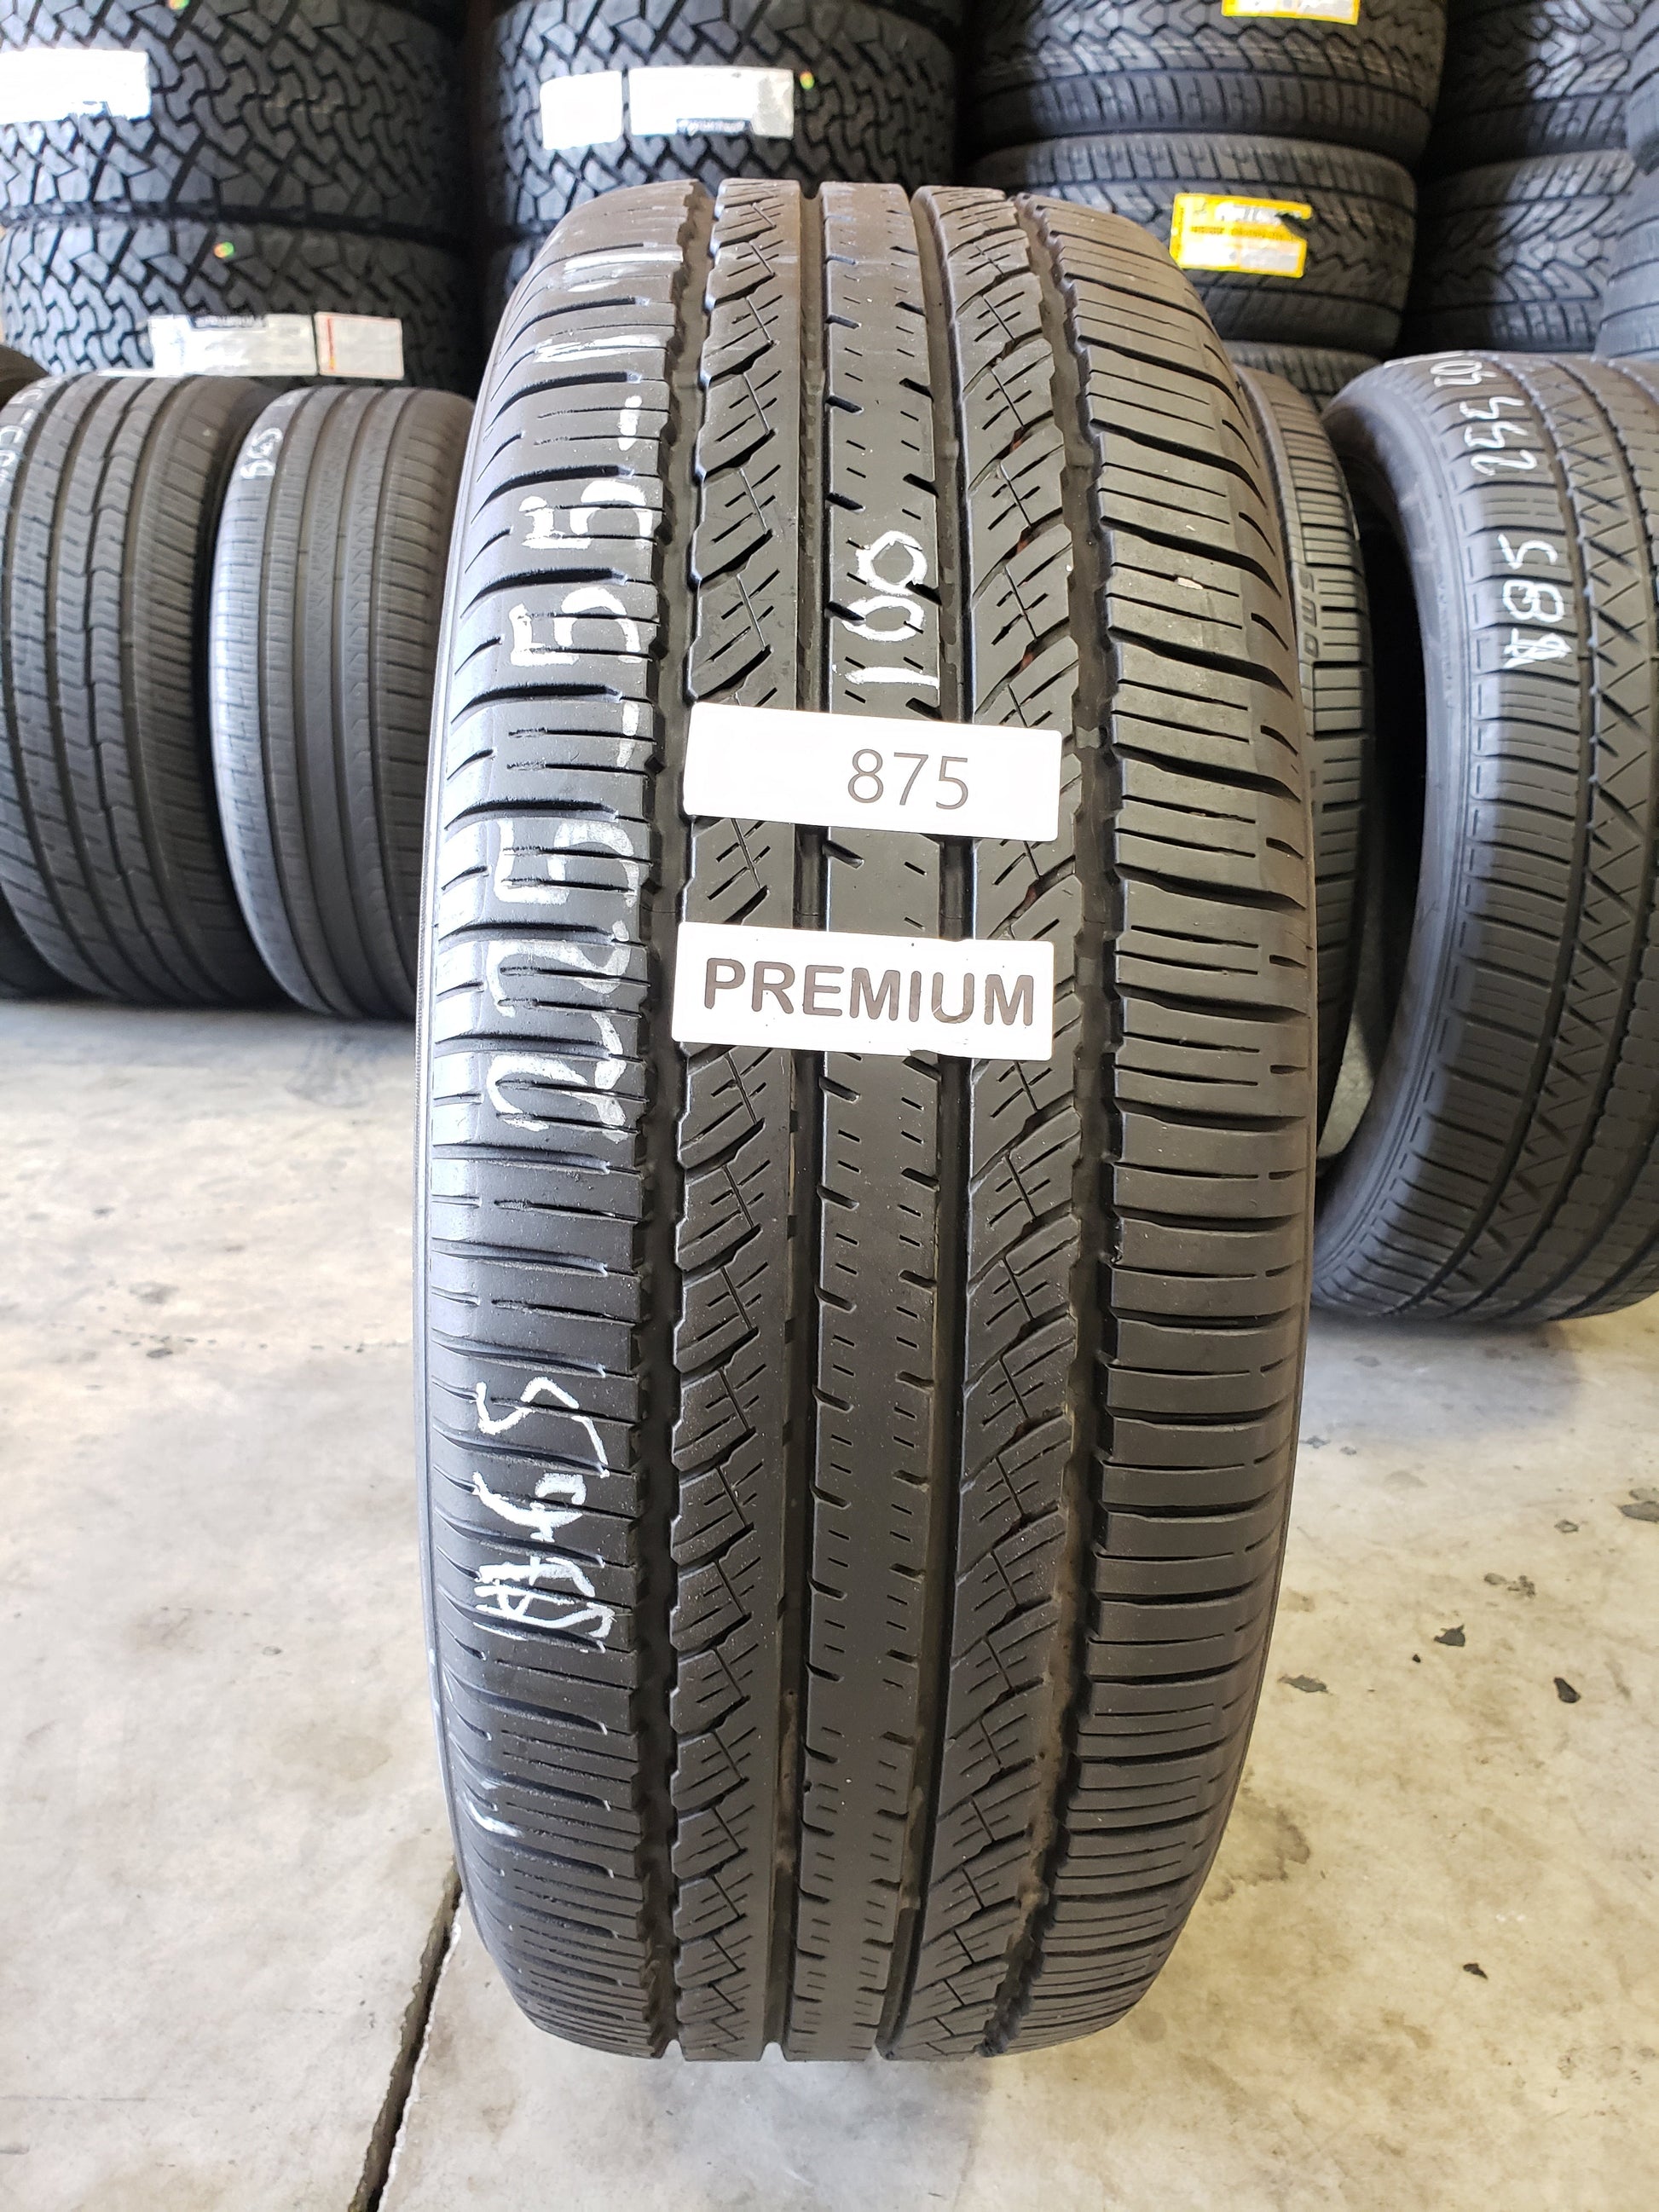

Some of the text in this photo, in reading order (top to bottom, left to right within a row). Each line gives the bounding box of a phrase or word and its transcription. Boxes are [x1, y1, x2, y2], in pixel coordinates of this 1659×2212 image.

[1460, 396, 1537, 476] 255
[1298, 569, 1320, 659] DWS
[847, 748, 968, 811] 875
[703, 957, 1034, 1026] PREMIUM
